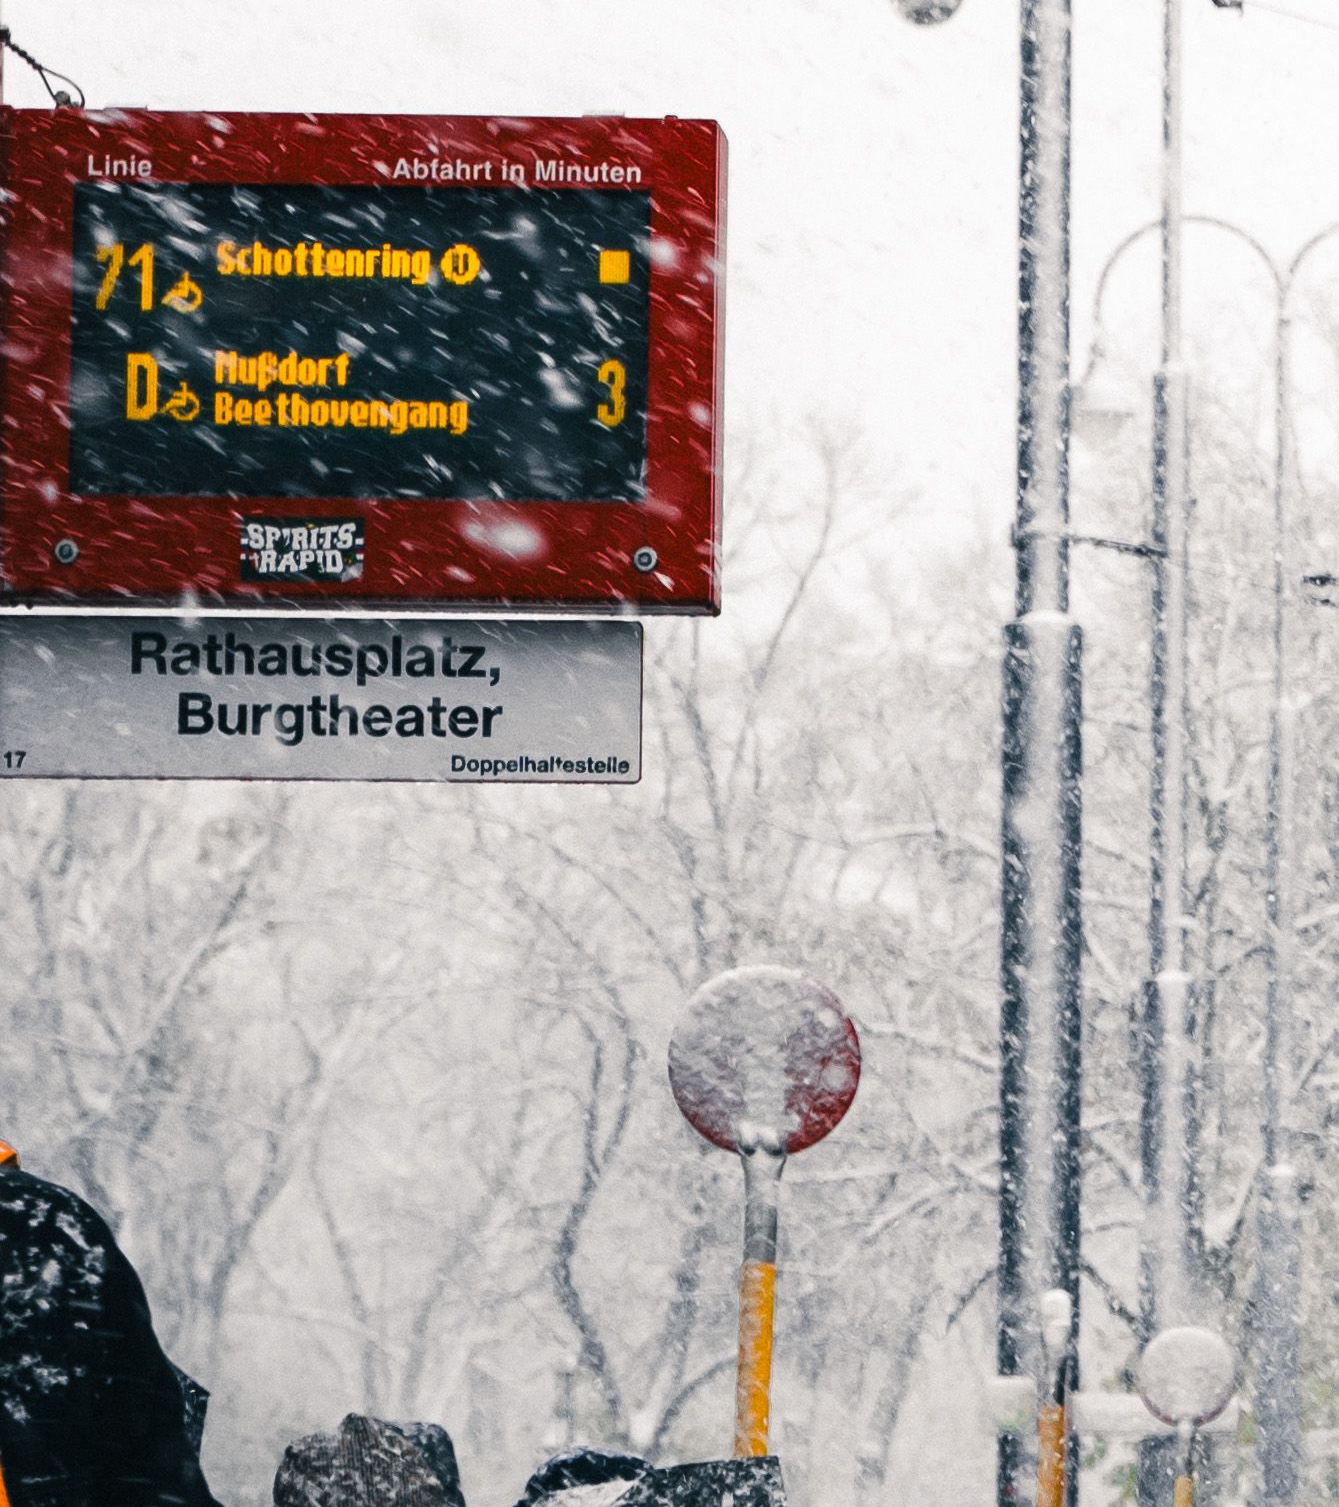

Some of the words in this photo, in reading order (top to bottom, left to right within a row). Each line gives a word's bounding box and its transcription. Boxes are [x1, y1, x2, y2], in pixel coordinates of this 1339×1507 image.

[87, 155, 152, 177] Linie
[393, 158, 492, 180] Abfahrt
[501, 160, 525, 182] in
[534, 160, 642, 183] Minuten
[95, 243, 154, 311] 71
[216, 241, 431, 285] Schottenring
[126, 352, 158, 420] D
[214, 350, 349, 391] Nußdorf
[214, 392, 469, 434] Beethovengang
[597, 360, 626, 426] 3
[246, 522, 357, 550] SPIRITS
[258, 549, 344, 573] RAPID
[130, 632, 501, 686] Rathausplatz,
[177, 692, 503, 746] Burgtheater
[3, 750, 27, 769] 17
[451, 755, 631, 776] Doppelhaltestelle
